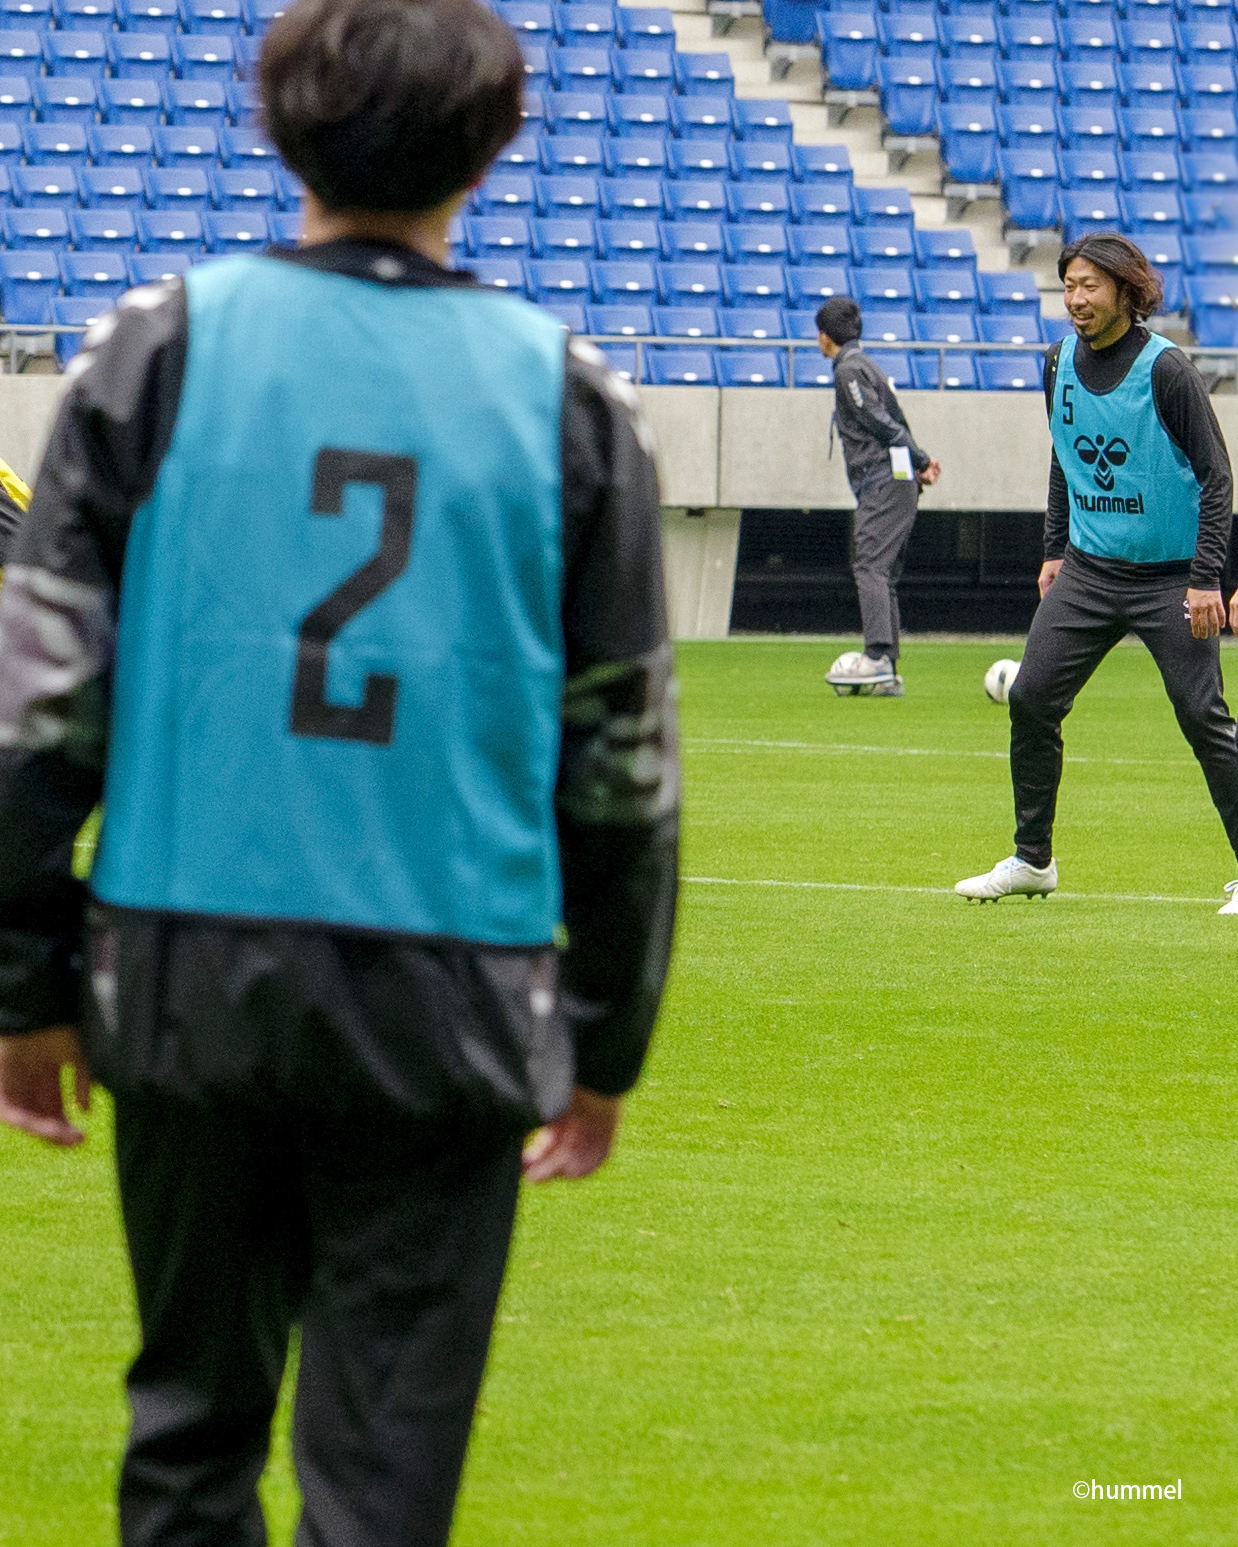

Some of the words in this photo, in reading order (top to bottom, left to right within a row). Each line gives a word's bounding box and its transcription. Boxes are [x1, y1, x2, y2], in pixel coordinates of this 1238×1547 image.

[1062, 384, 1074, 425] 5
[1073, 489, 1145, 514] hummel
[290, 447, 418, 746] 2
